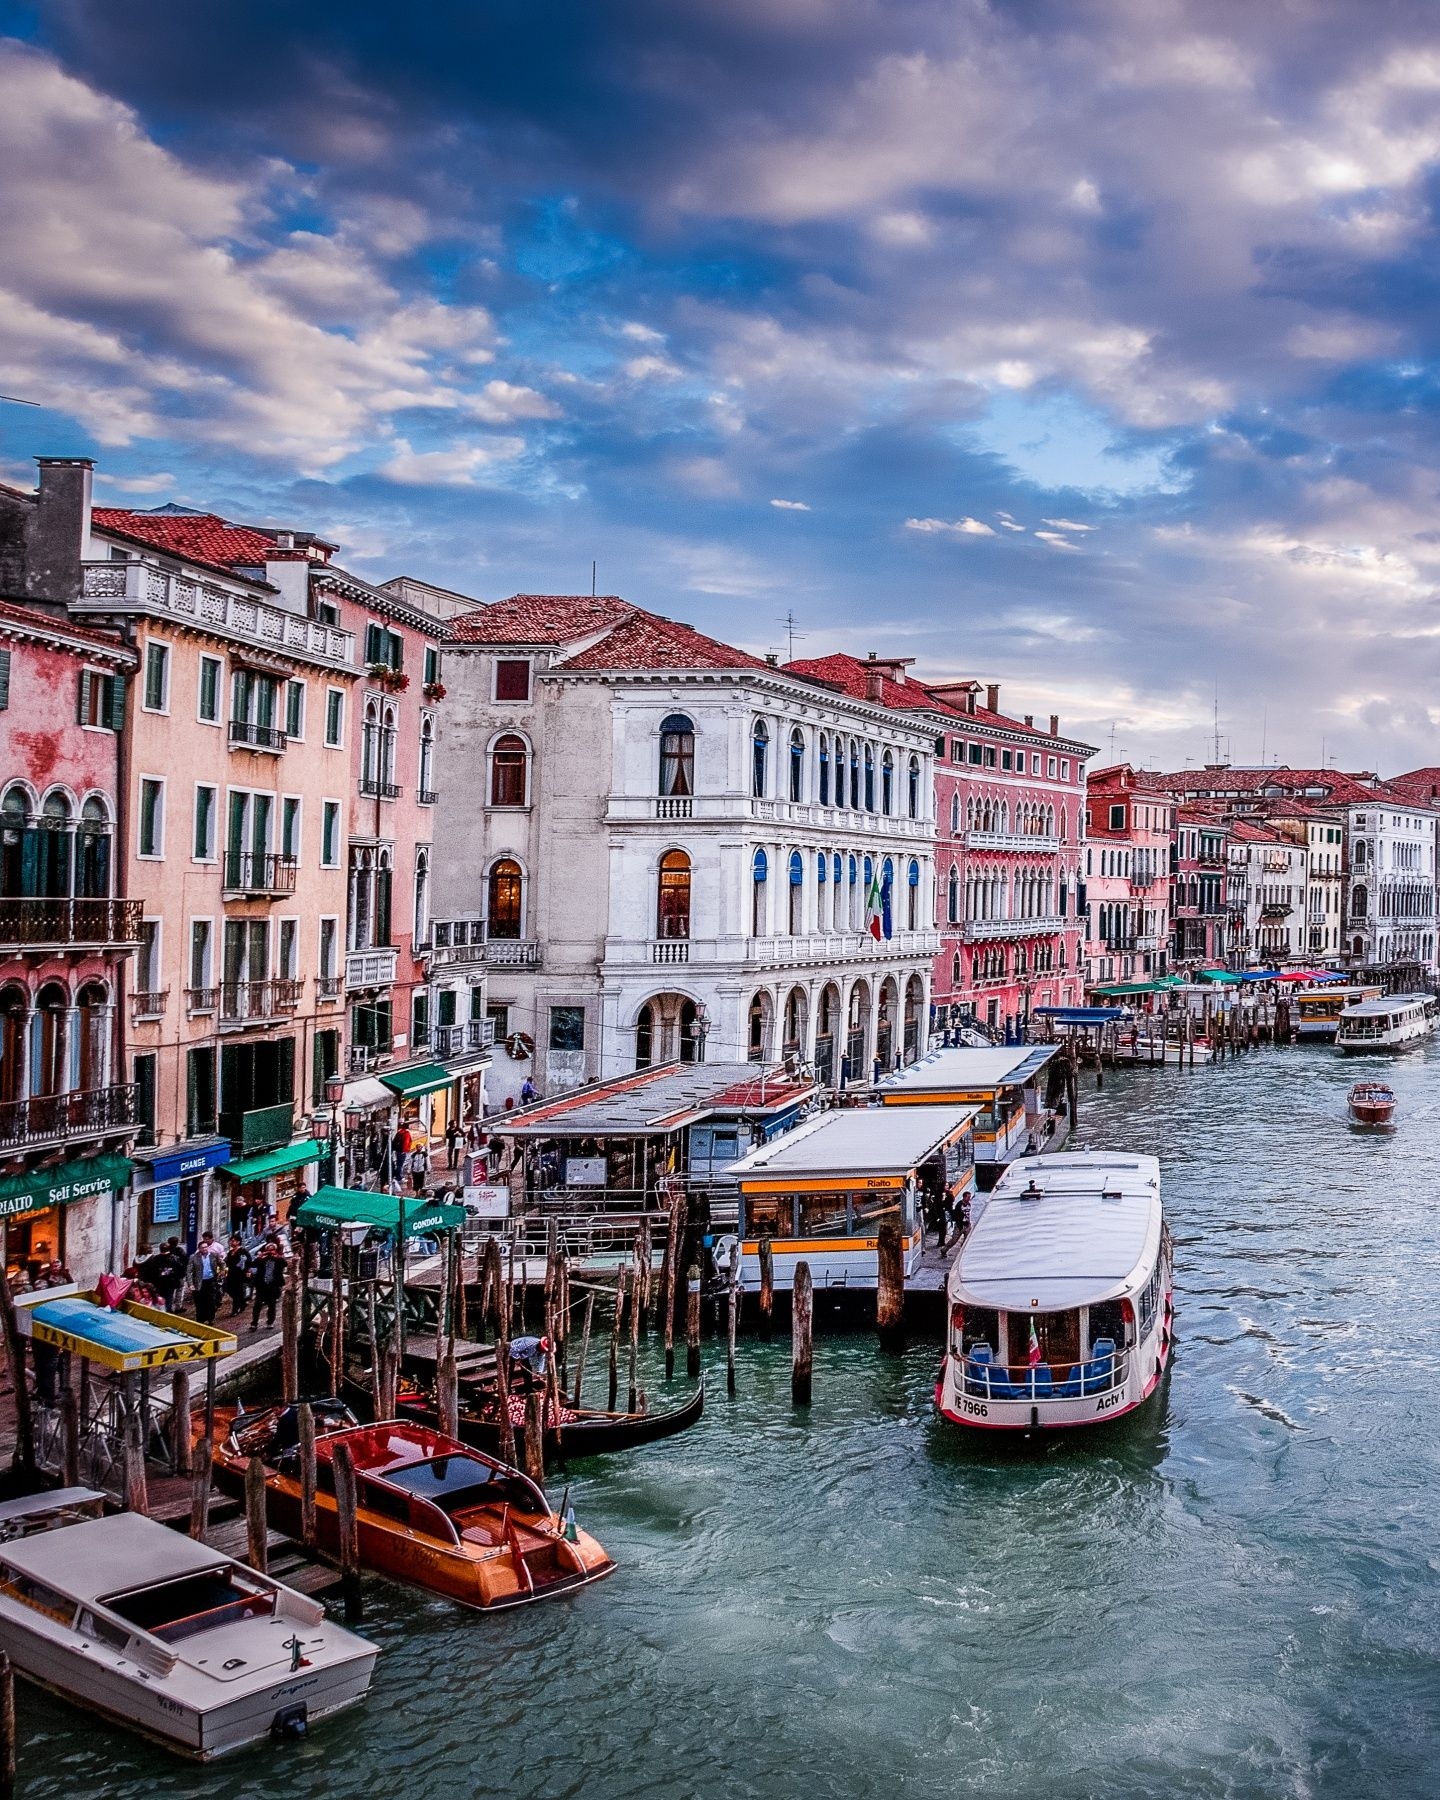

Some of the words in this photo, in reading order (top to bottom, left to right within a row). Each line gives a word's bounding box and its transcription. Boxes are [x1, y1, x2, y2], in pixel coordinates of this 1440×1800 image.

[180, 1156, 206, 1171] CHANGE
[49, 1184, 71, 1203] Self
[72, 1177, 111, 1197] Service
[867, 1179, 891, 1187] Rialto
[189, 1192, 197, 1232] CHANGE
[412, 1214, 443, 1231] GONDOLA
[42, 1325, 77, 1352] TAXI
[142, 1340, 220, 1365] TAXI
[963, 1399, 988, 1417] 7966
[1096, 1393, 1120, 1411] Actv
[1121, 1388, 1125, 1400] 1
